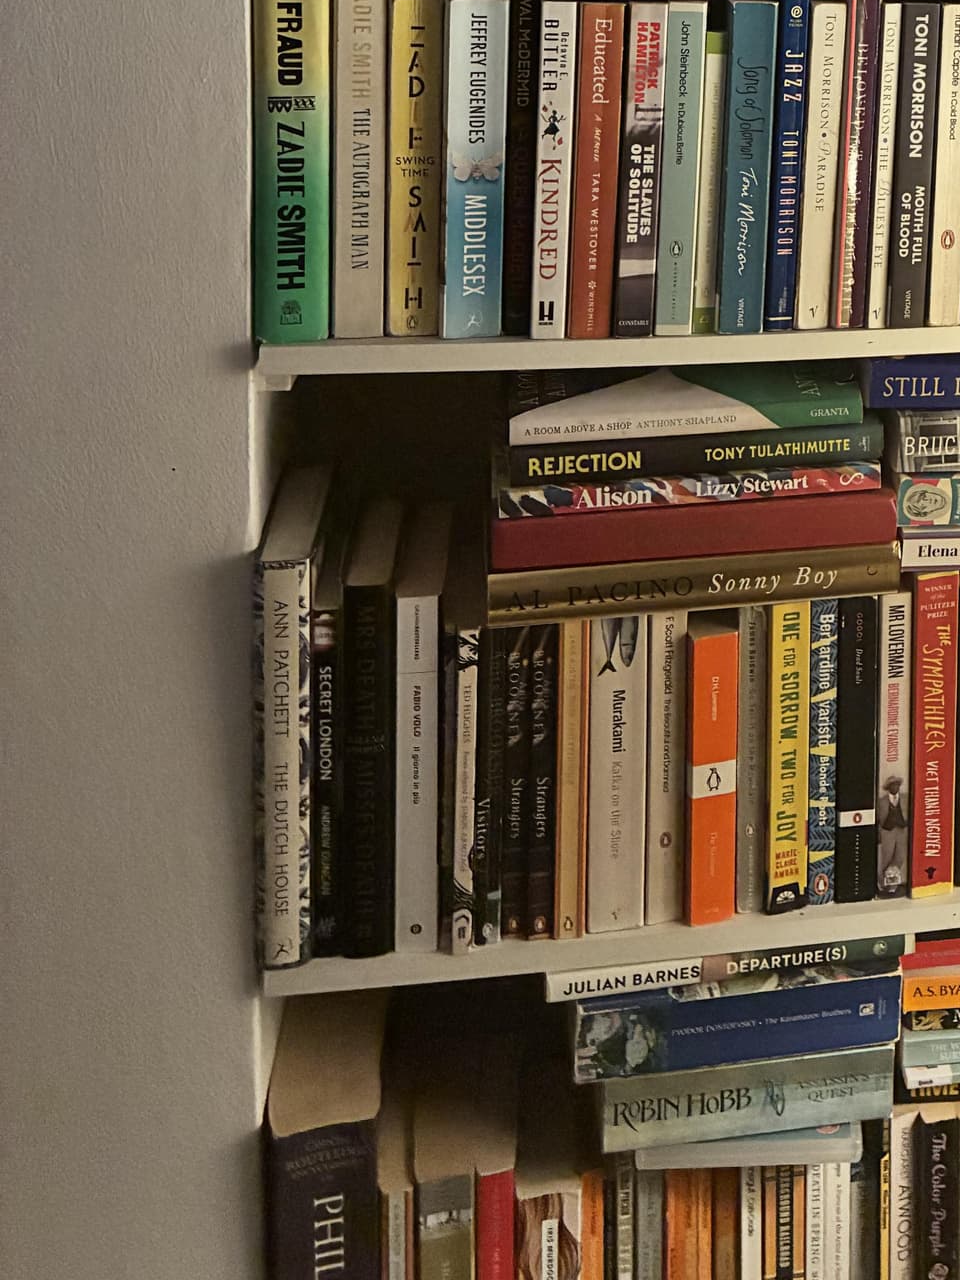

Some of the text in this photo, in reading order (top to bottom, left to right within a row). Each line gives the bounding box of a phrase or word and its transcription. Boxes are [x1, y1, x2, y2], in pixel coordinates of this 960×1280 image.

[277, 2, 304, 86] FRAUD
[468, 13, 488, 145] JEFFREY EUGENIDES
[591, 17, 613, 105] Educated
[908, 14, 929, 159] TONI MORRISON
[276, 122, 305, 200] ZADIE
[626, 144, 642, 244] OF SOLITUDE
[641, 145, 655, 236] THE SLAVES
[277, 204, 306, 292] SMITH
[462, 194, 487, 297] MIDDLESEX
[539, 158, 562, 280] KINDRED
[898, 193, 912, 258] OF BLOOD
[912, 185, 927, 265] MOUTH FULL
[883, 376, 945, 398] STILL
[528, 438, 851, 477] REJECTION TONY TULATHIMUTTE
[576, 488, 652, 509] Alison
[708, 566, 839, 596] Sonny Boy
[918, 543, 958, 559] Elena
[272, 599, 290, 917] ANN PATCHETT THE DUTCH HOUSE
[319, 665, 332, 782] SECRET LONDON
[563, 945, 847, 997] JULIAN BARNES DEPARTURE(S)
[913, 986, 937, 998] A.S.
